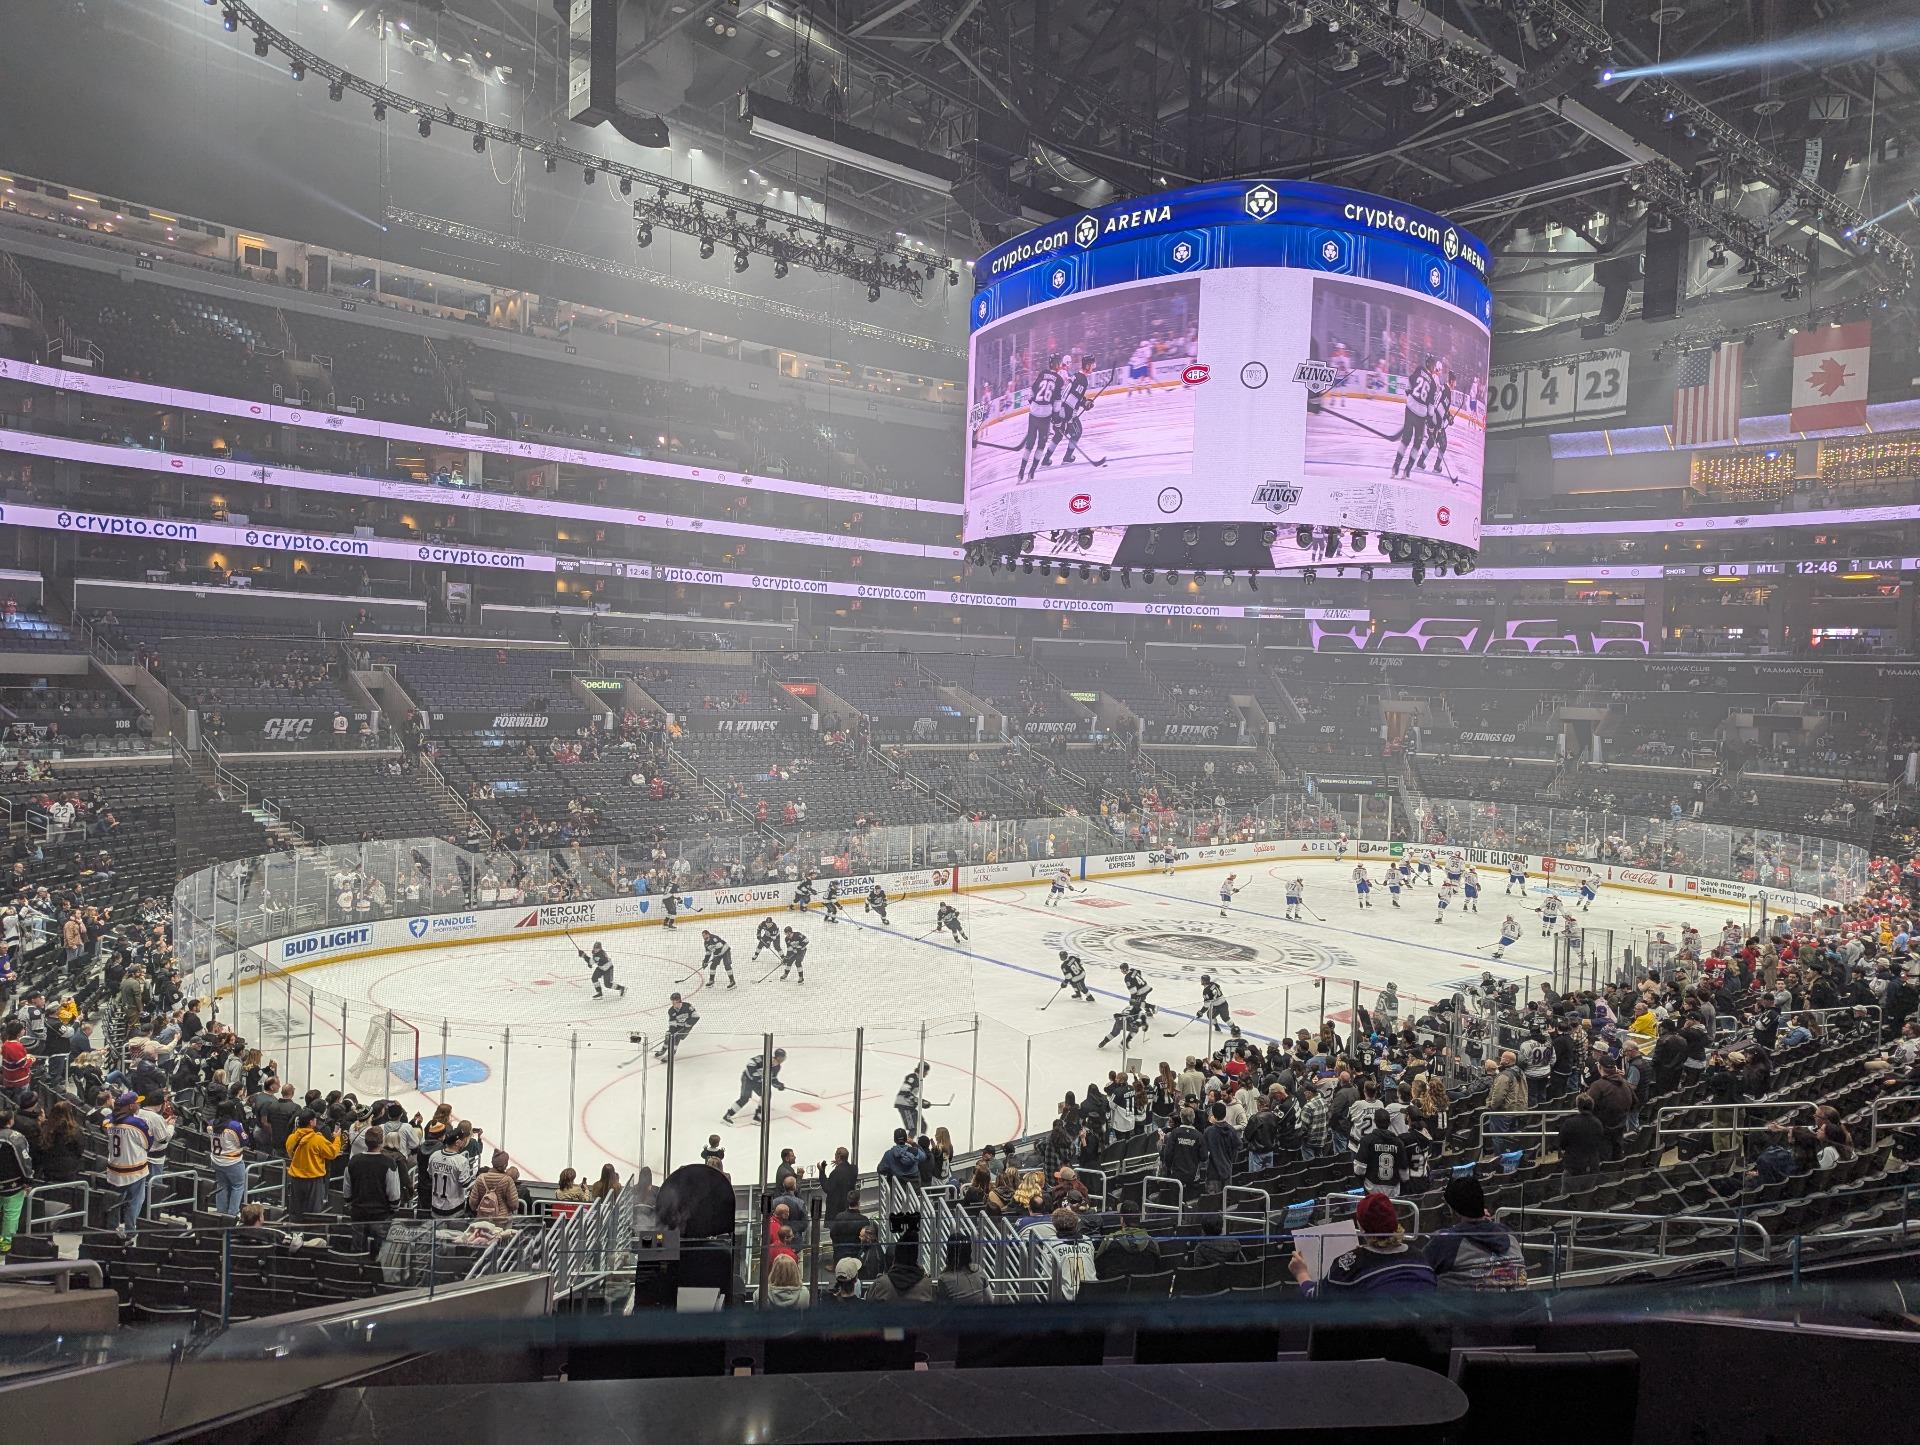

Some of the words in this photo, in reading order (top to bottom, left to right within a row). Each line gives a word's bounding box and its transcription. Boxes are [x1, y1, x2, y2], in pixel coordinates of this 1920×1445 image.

[1104, 205, 1171, 234] ARENA
[1344, 203, 1440, 245] crypto.com
[992, 230, 1068, 274] crypto.com
[1461, 244, 1485, 274] ARENA
[1299, 367, 1335, 383] KINGS
[1035, 380, 1056, 402] 26
[1413, 376, 1430, 402] 26
[1540, 377, 1559, 405] 4
[1584, 368, 1621, 401] 23
[1487, 383, 1518, 412] 20
[1258, 488, 1298, 502] KINGS
[75, 514, 197, 540] crypto.com
[262, 532, 369, 555] crypto.com
[433, 548, 525, 568] crypto.com
[1869, 560, 1893, 570] LAK
[1729, 565, 1737, 575] 0
[1757, 564, 1779, 573] MTL
[1796, 561, 1837, 574] 12:46
[665, 568, 723, 583] ypto.com
[762, 577, 828, 593] crypto.com
[867, 585, 926, 601] crypto.com
[959, 593, 1017, 608] crypto.com
[1052, 599, 1113, 612] crypto.com
[1154, 604, 1220, 616] crypto.com
[1323, 609, 1351, 619] KINGS
[581, 679, 621, 690] Spectrum
[115, 720, 130, 728] 108
[354, 713, 368, 721] 109
[493, 716, 549, 728] FORWARD
[1025, 722, 1037, 733] GO
[1460, 731, 1473, 741] GO
[1473, 731, 1502, 743] KINGS
[1502, 732, 1516, 743] GO
[54, 807, 68, 818] 22
[1104, 854, 1136, 863] AMERICAN
[1465, 848, 1488, 863] TRUE
[1108, 861, 1136, 870] EXPRESS
[1450, 860, 1460, 868] 35
[1559, 863, 1593, 874] TOYOTA
[1700, 879, 1719, 888] Save
[1720, 882, 1746, 892] money
[1700, 886, 1718, 894] with
[1719, 889, 1732, 897] the
[1732, 891, 1747, 899] app
[715, 890, 780, 905] VANCOUVER
[540, 904, 596, 918] MERCURY
[615, 902, 639, 914] blue
[1545, 902, 1557, 911] 48
[433, 915, 477, 927] FANDUEL
[539, 911, 596, 925] INSURANCE
[285, 934, 318, 958] BUD
[320, 928, 369, 949] LIGHT
[1374, 1143, 1398, 1153] DOUGHTY
[1378, 1152, 1395, 1181] 8
[432, 1172, 448, 1199] 11
